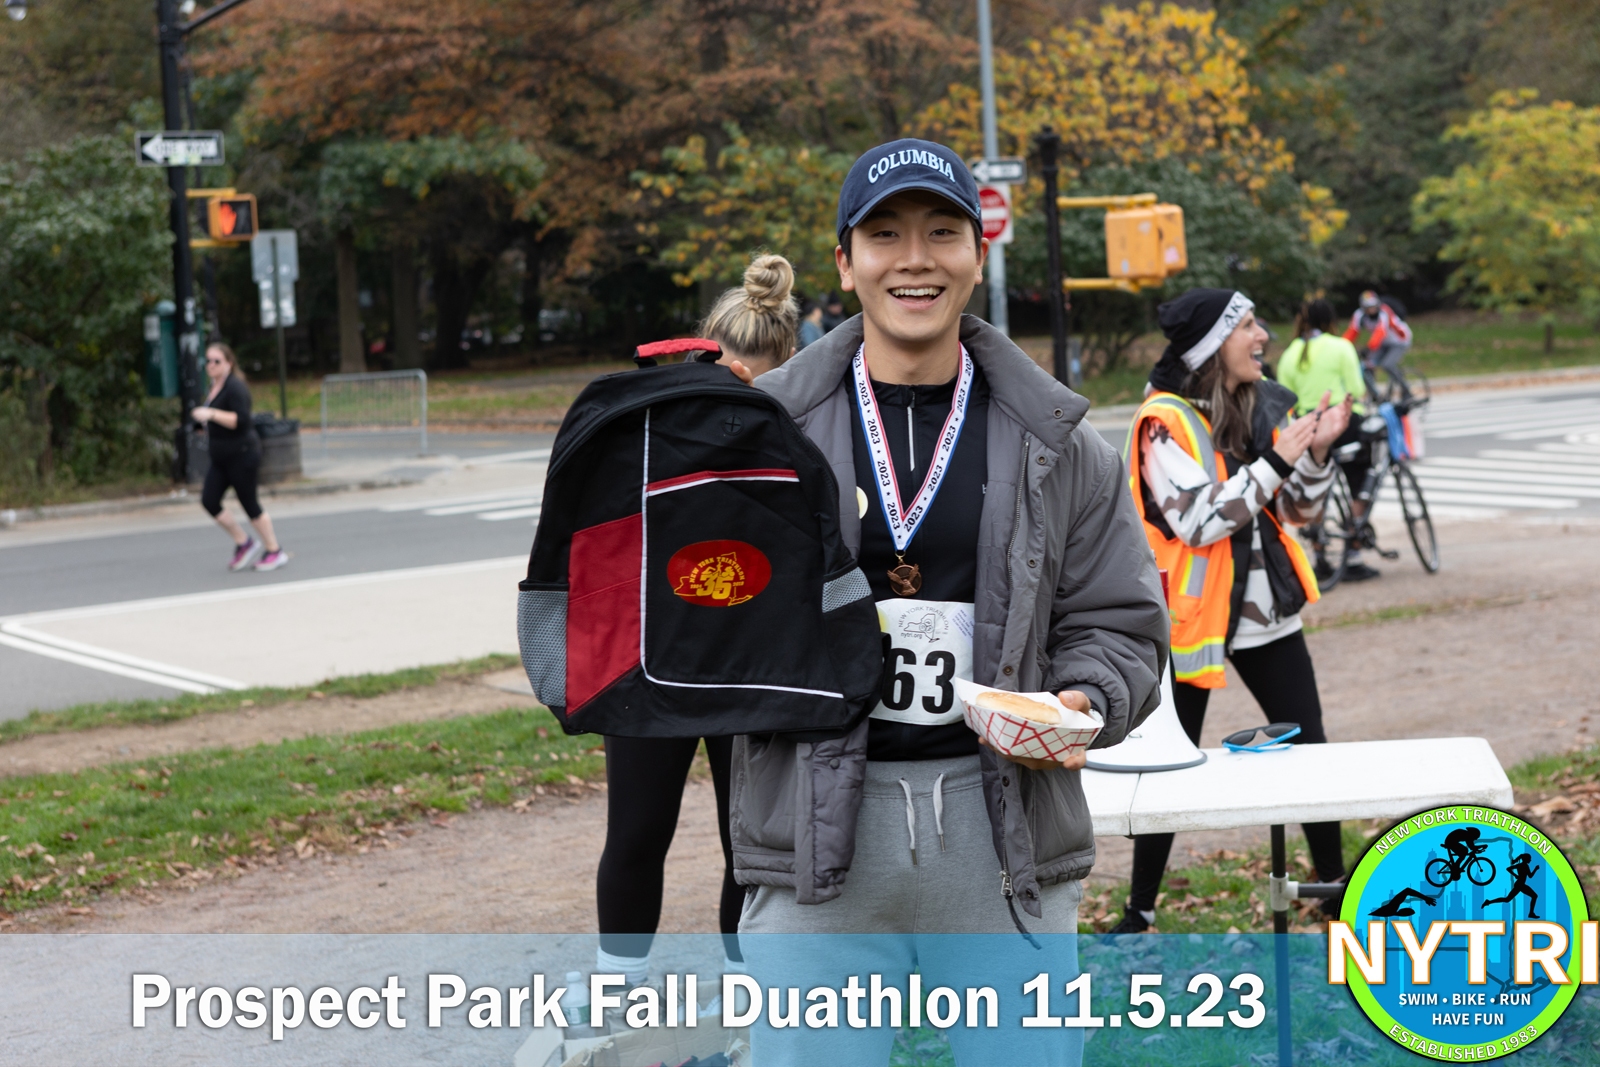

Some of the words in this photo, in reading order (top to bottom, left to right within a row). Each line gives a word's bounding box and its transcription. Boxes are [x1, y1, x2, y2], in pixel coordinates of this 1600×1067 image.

[868, 149, 955, 184] COLUMBIA
[859, 380, 870, 406] 2023
[867, 418, 881, 445] 2023
[877, 460, 891, 487] 2023
[886, 502, 901, 530] 2023
[903, 505, 924, 532] 2023
[927, 464, 943, 492] 2023
[942, 425, 956, 452] 2023
[957, 387, 966, 413] 2023
[689, 567, 699, 583] NEW
[697, 557, 715, 568] YORK
[716, 556, 745, 580] TRIATHLON
[696, 571, 734, 599] 35
[898, 613, 907, 628] NEW
[906, 606, 924, 615] YORK
[925, 606, 949, 631] TRIATHLON
[900, 632, 923, 640] nytri.org
[882, 648, 956, 714] 63
